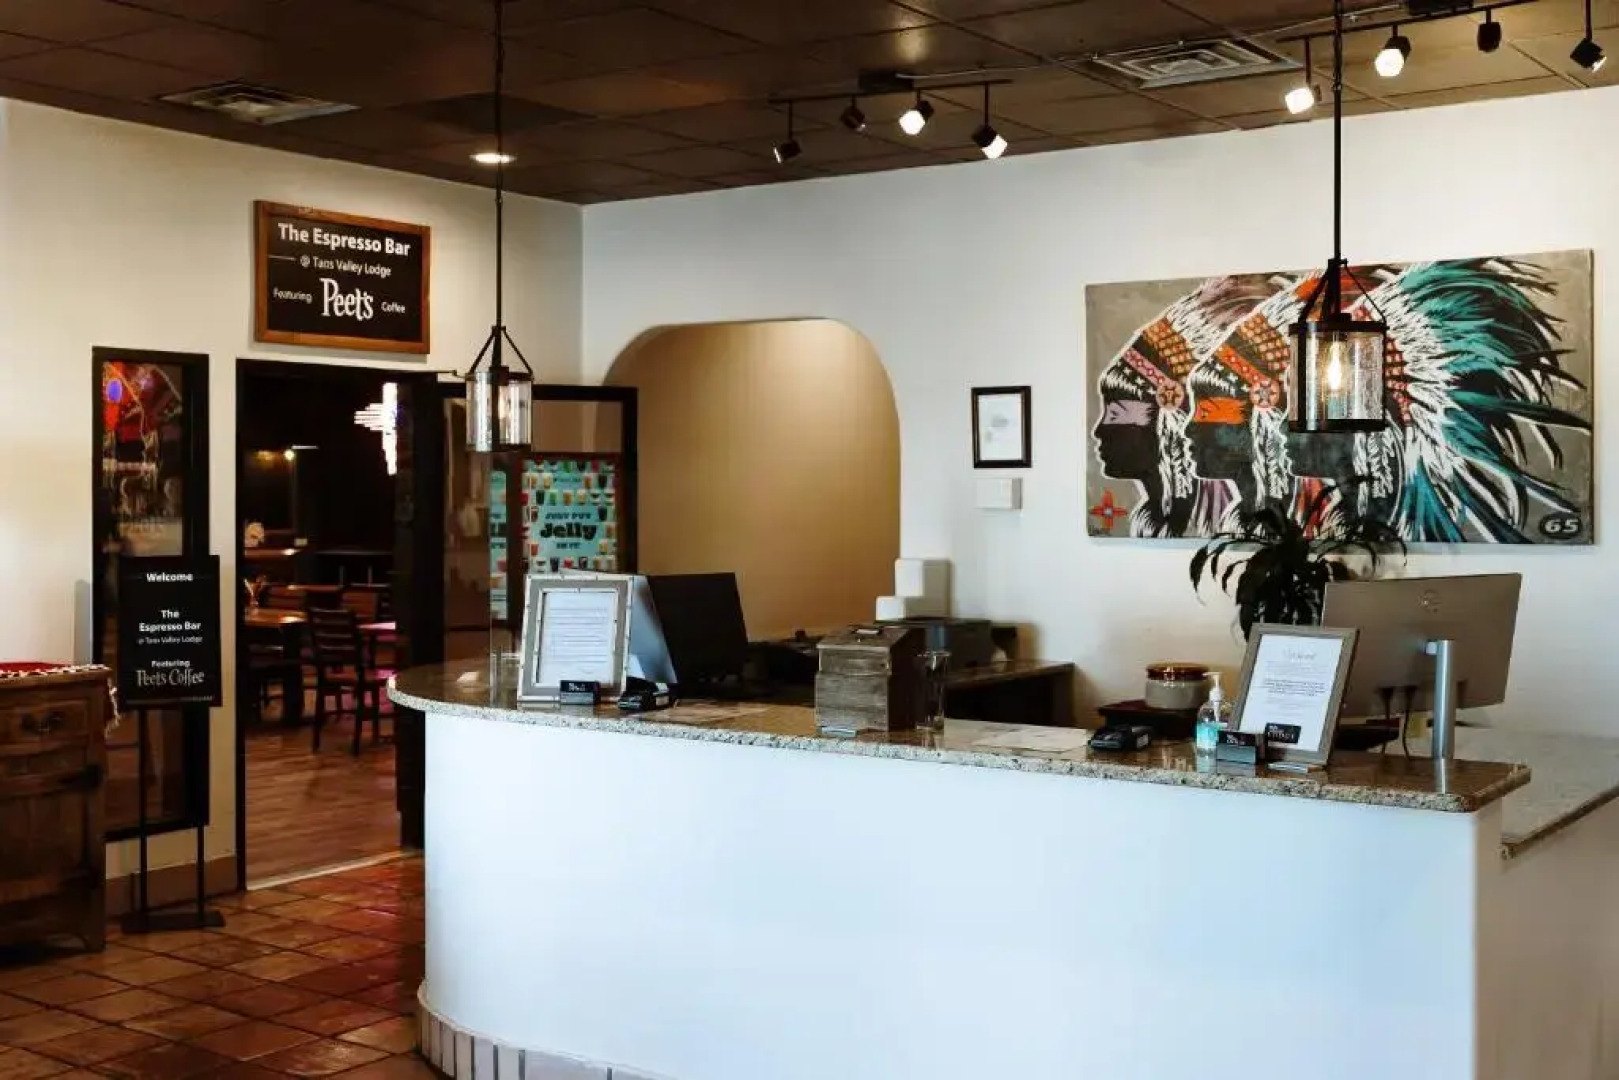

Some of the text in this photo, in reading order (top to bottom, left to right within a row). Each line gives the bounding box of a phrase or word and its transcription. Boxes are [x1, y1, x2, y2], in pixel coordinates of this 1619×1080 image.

[278, 223, 411, 256] The Espresso Bar
[300, 255, 392, 278] @ Taos Valley Lodge
[273, 287, 313, 304] Featuring
[381, 302, 406, 314] Coffee
[540, 522, 597, 540] Jelly
[1545, 519, 1579, 532] 65
[146, 572, 194, 583] Welcome
[160, 609, 180, 619] The
[139, 621, 202, 633] Espresso Bar
[151, 659, 191, 668] Featuring
[169, 668, 205, 687] Coffee
